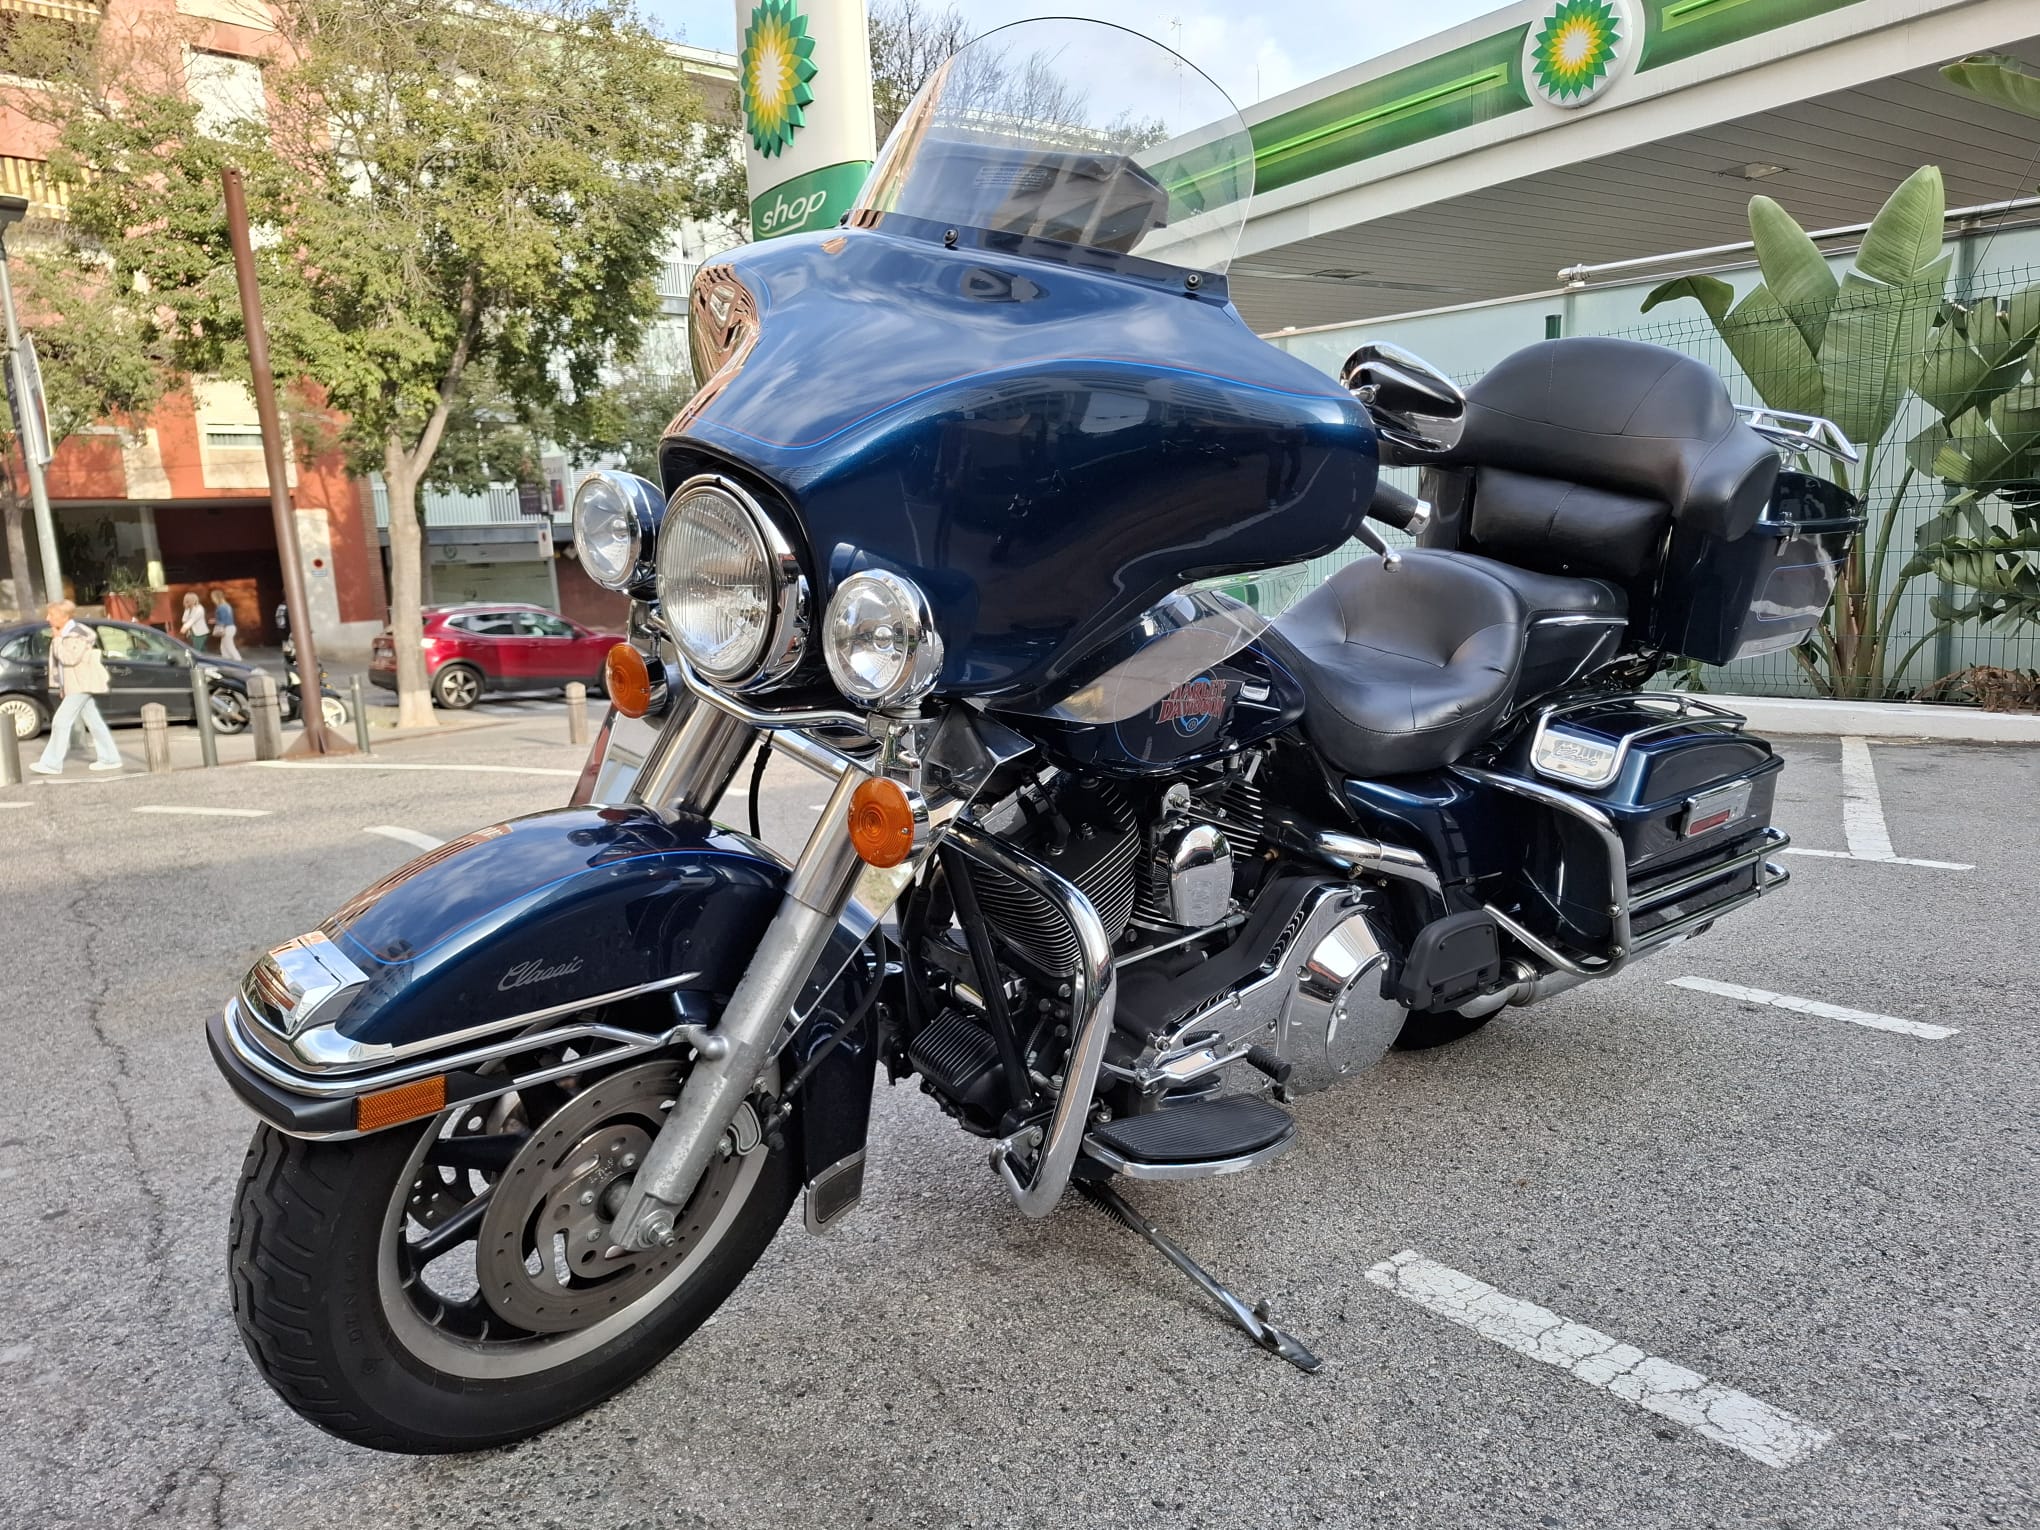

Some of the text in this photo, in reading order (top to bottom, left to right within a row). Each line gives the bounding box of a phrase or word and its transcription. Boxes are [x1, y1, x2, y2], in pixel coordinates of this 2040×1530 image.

[759, 190, 827, 237] shop
[1155, 697, 1227, 724] DAVIDSON
[497, 955, 584, 992] Classic
